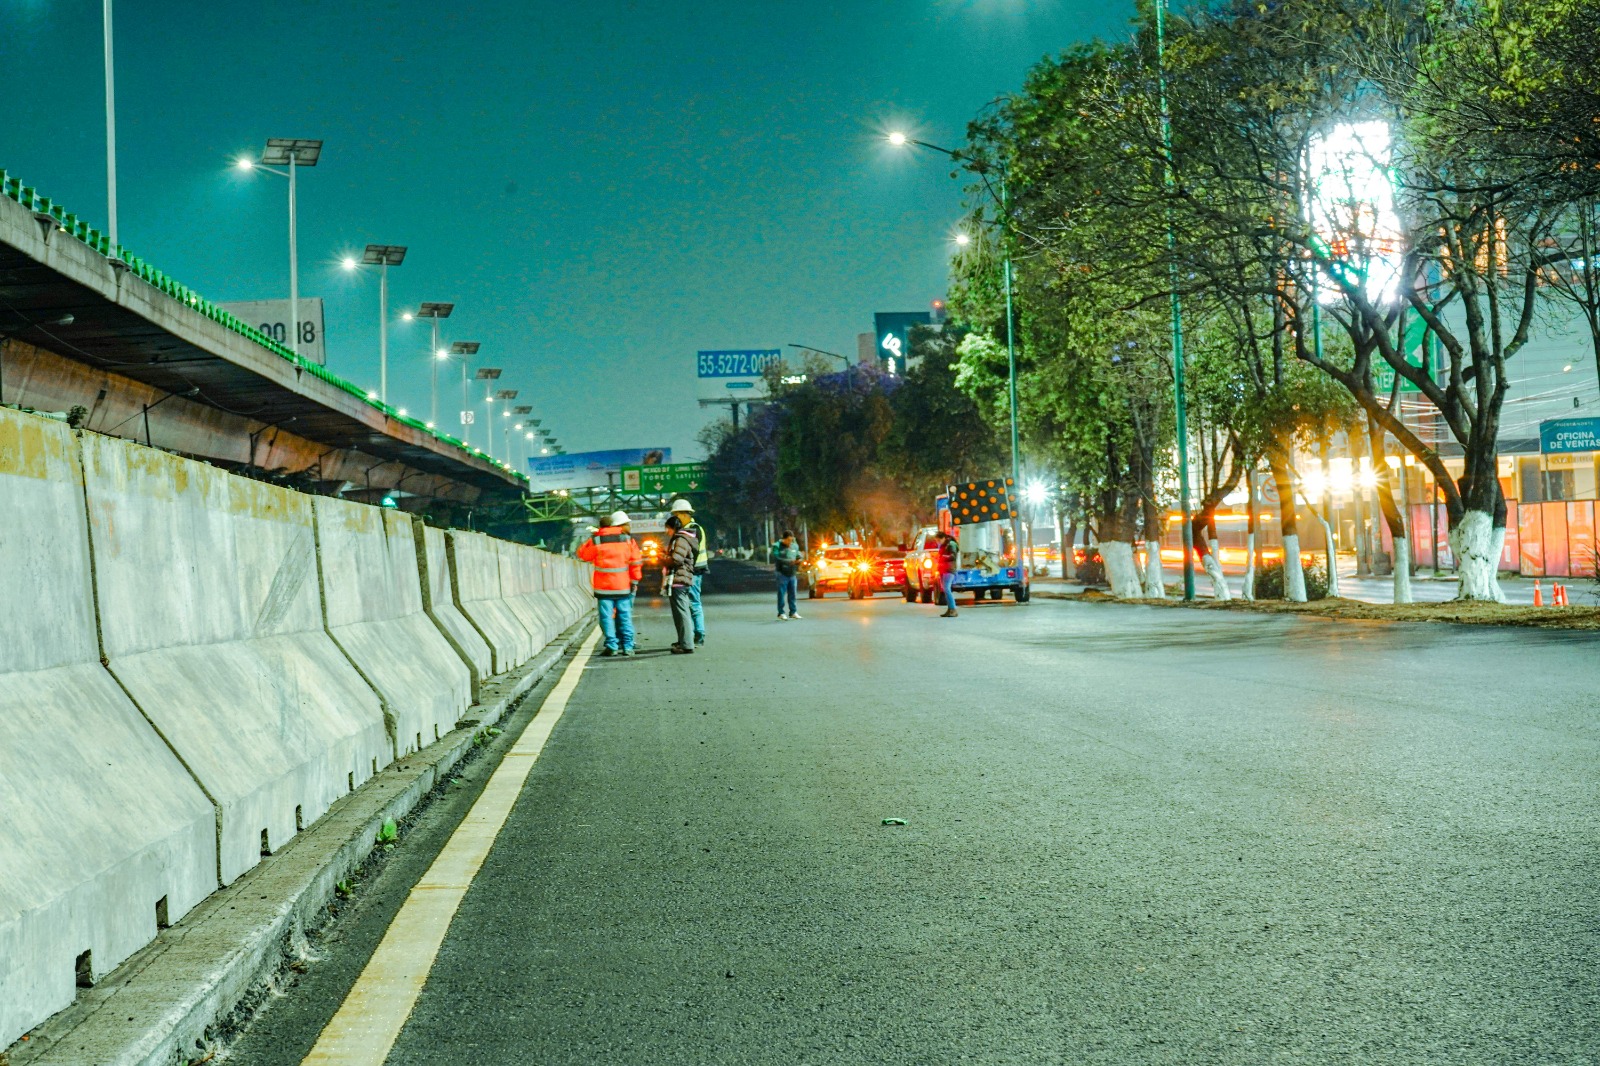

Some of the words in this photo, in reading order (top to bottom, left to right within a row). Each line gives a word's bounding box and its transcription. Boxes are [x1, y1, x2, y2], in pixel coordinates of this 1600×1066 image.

[1556, 431, 1595, 440] OFICINA
[1550, 441, 1563, 449] DE
[1565, 438, 1600, 448] VENTAS
